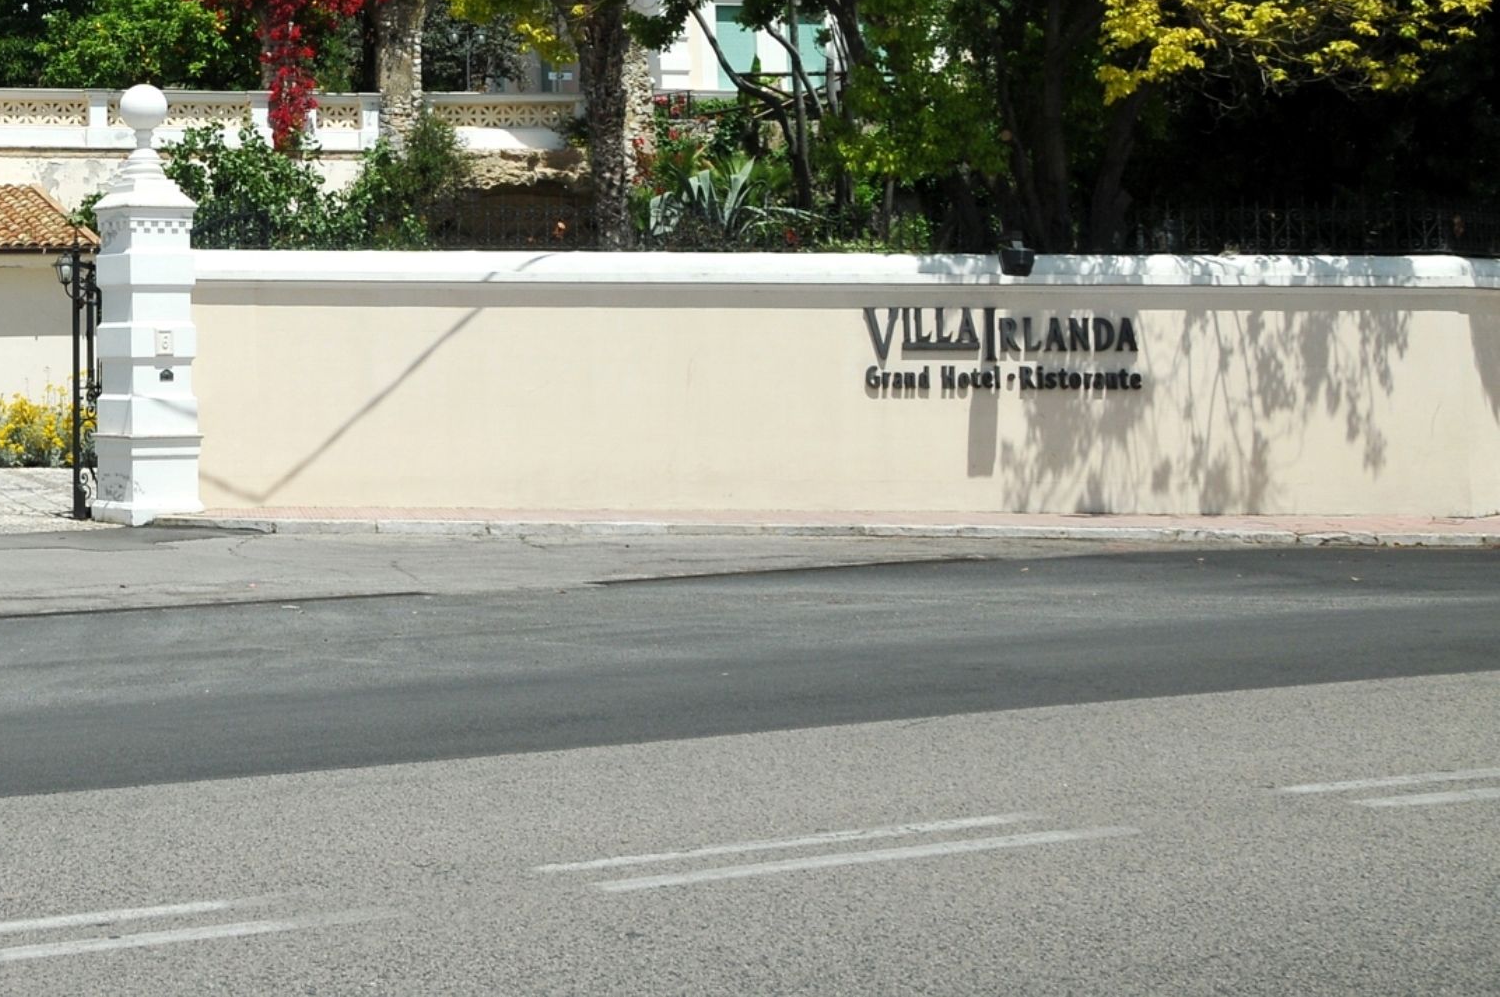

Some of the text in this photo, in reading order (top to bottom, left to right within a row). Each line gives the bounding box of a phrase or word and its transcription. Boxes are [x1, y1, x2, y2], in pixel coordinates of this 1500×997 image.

[863, 307, 1139, 361] VILLA IRLANDA
[865, 366, 1142, 390] Grand Hotel Ristorante
